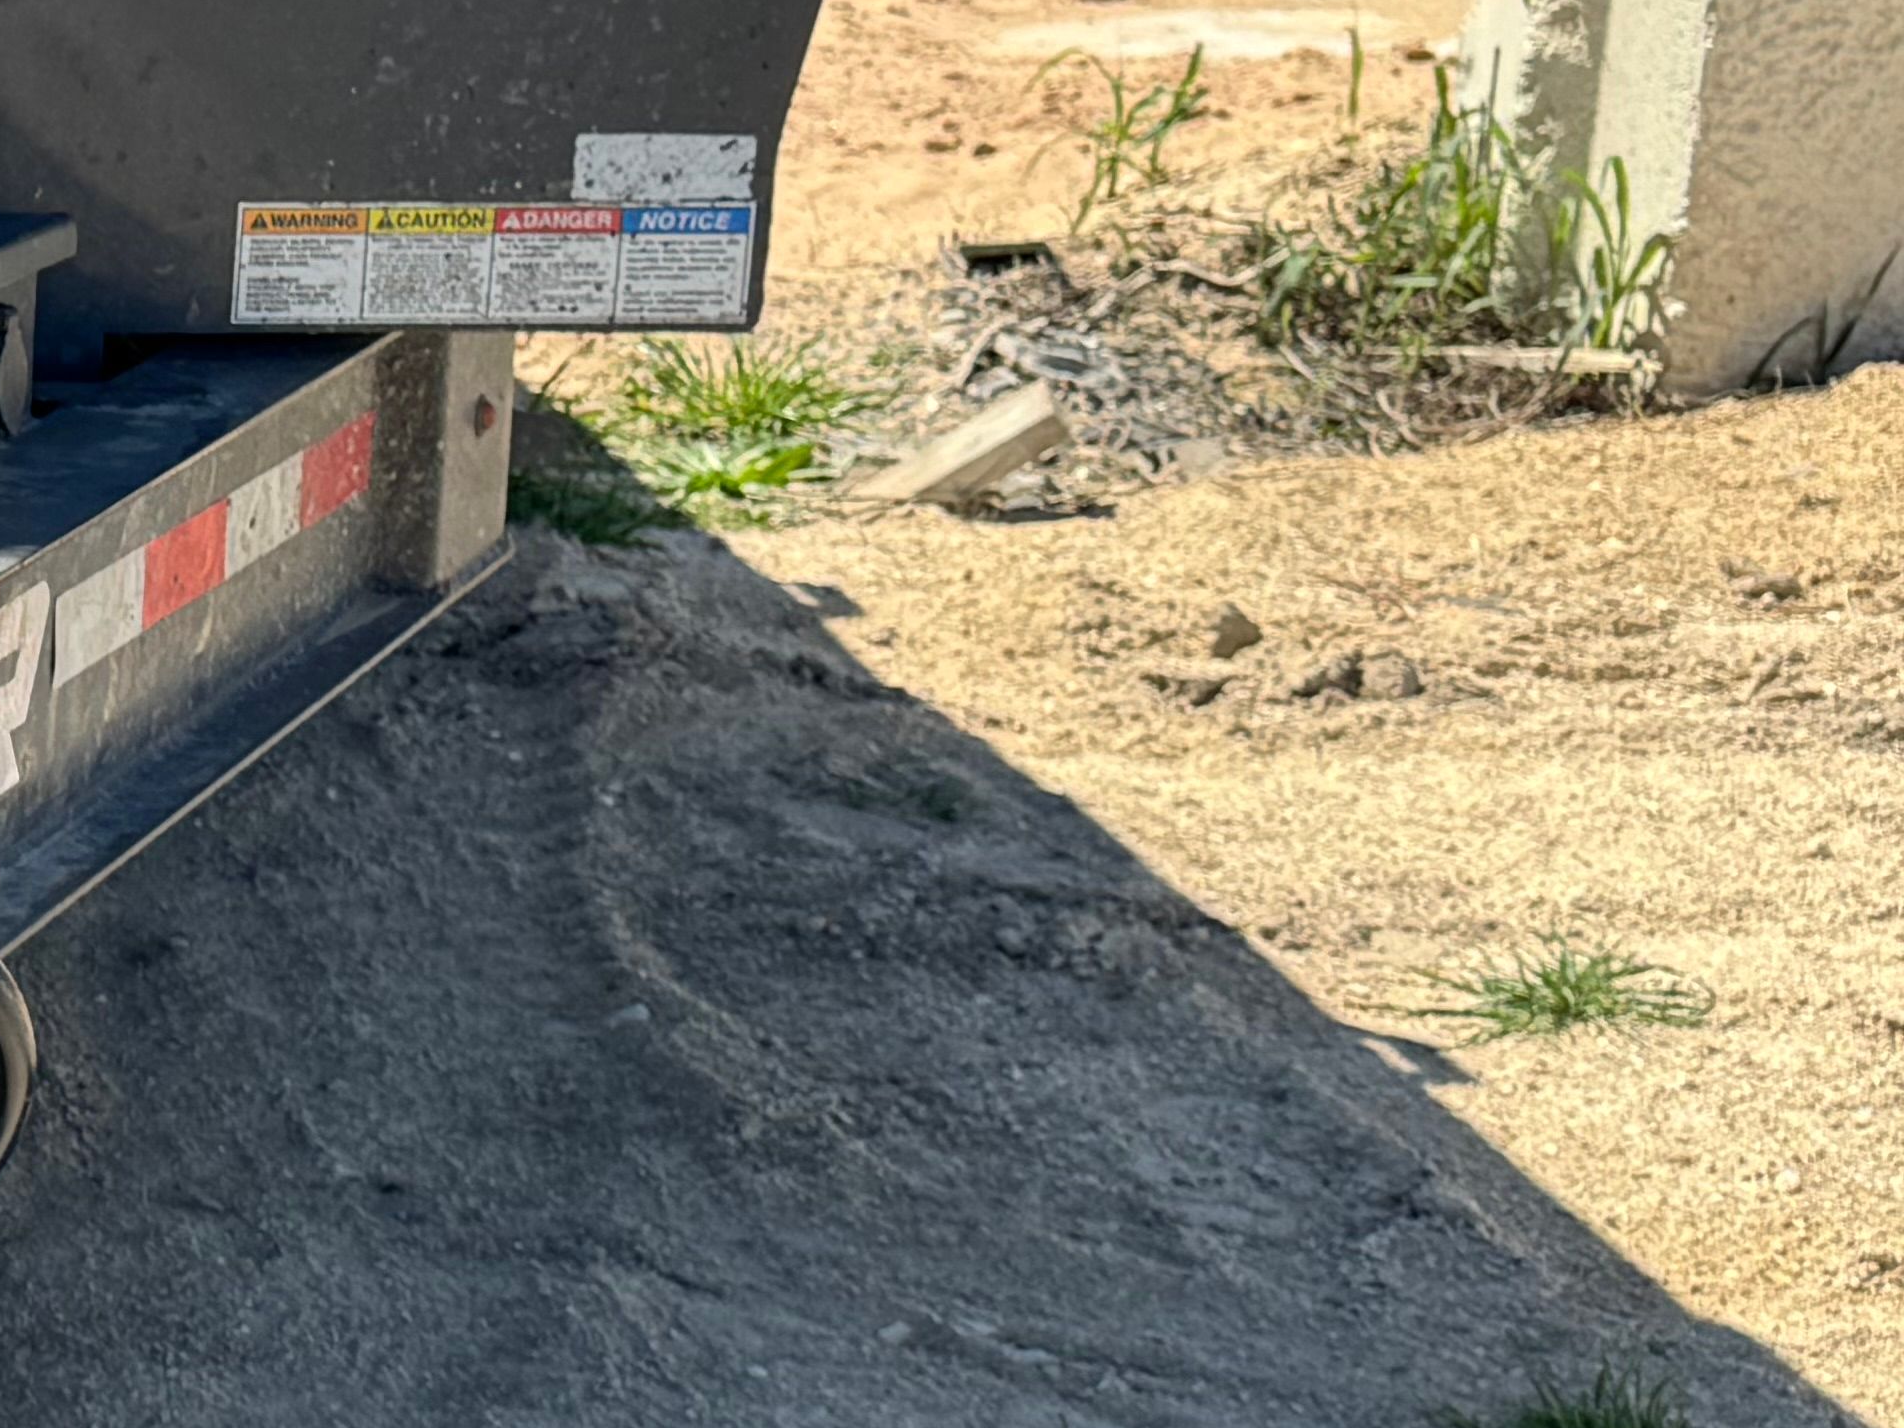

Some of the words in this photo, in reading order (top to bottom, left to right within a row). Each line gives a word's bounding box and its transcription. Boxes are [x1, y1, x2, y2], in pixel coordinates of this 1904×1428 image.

[270, 212, 358, 230] WARNING
[396, 210, 486, 230] CAUTION
[523, 212, 613, 230] DANGER
[639, 211, 732, 231] NOTICE
